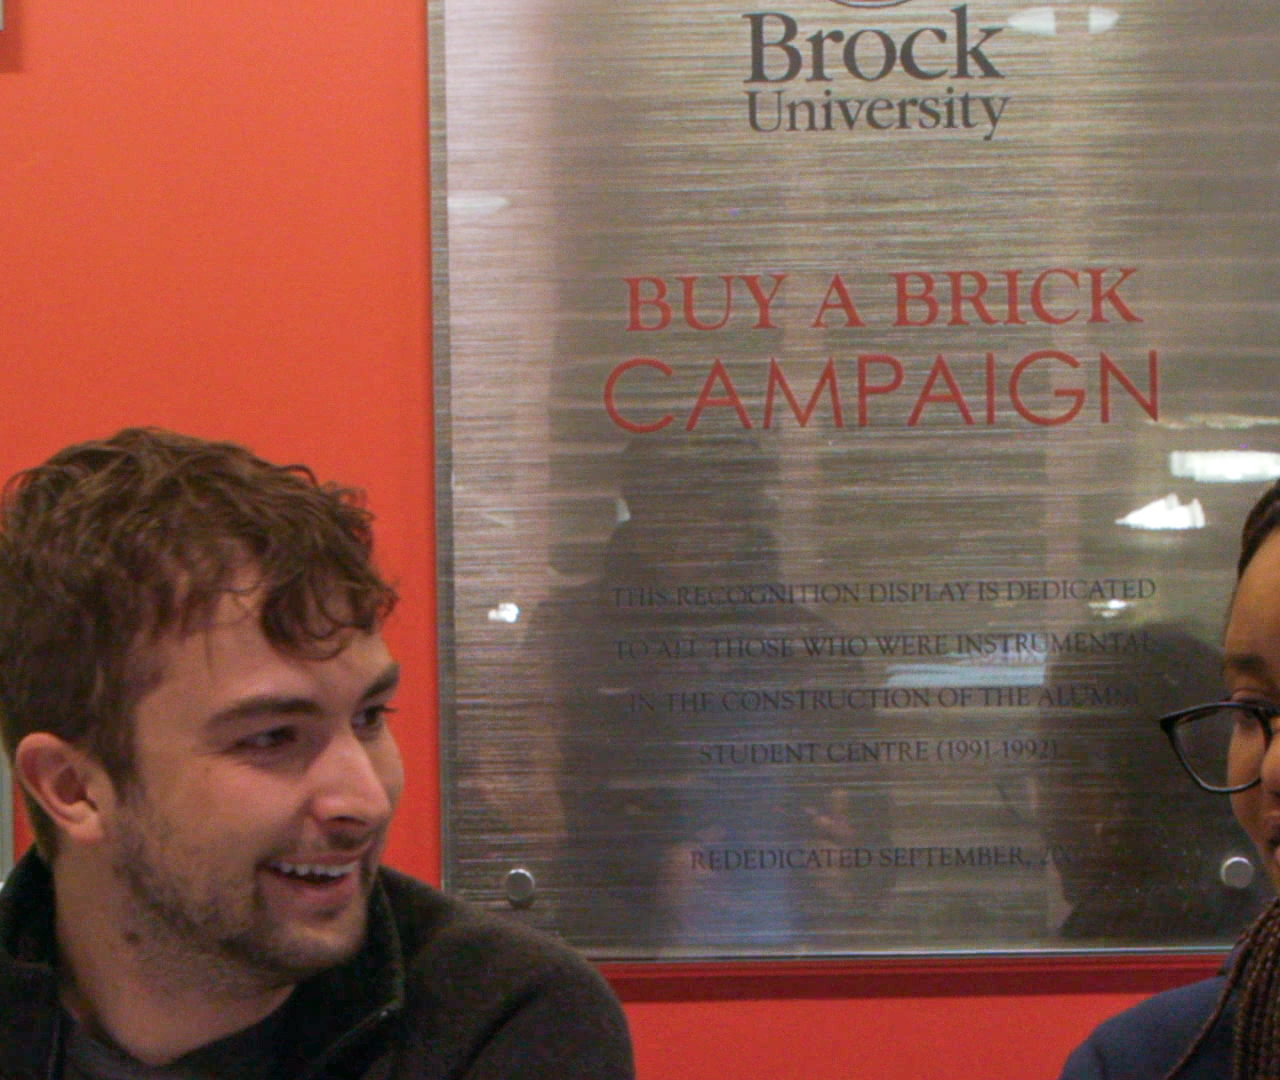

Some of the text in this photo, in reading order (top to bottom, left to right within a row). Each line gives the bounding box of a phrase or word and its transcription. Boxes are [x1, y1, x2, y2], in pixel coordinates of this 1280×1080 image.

[742, 5, 1007, 84] Brock
[743, 88, 1012, 140] University
[623, 268, 1143, 332] BUY A BRICK
[604, 350, 1160, 434] CAMPAIGN
[676, 577, 1157, 607] RECOGNITION DISPLAY IS DEDICATED
[712, 632, 947, 659] THOSE WHO WERE
[722, 687, 930, 712] CONSTRUCTION
[937, 687, 972, 709] OF
[980, 686, 1030, 708] THE
[699, 742, 820, 765] STUDENT
[826, 740, 929, 763] CENTRE
[691, 847, 872, 871] REDEDICATED
